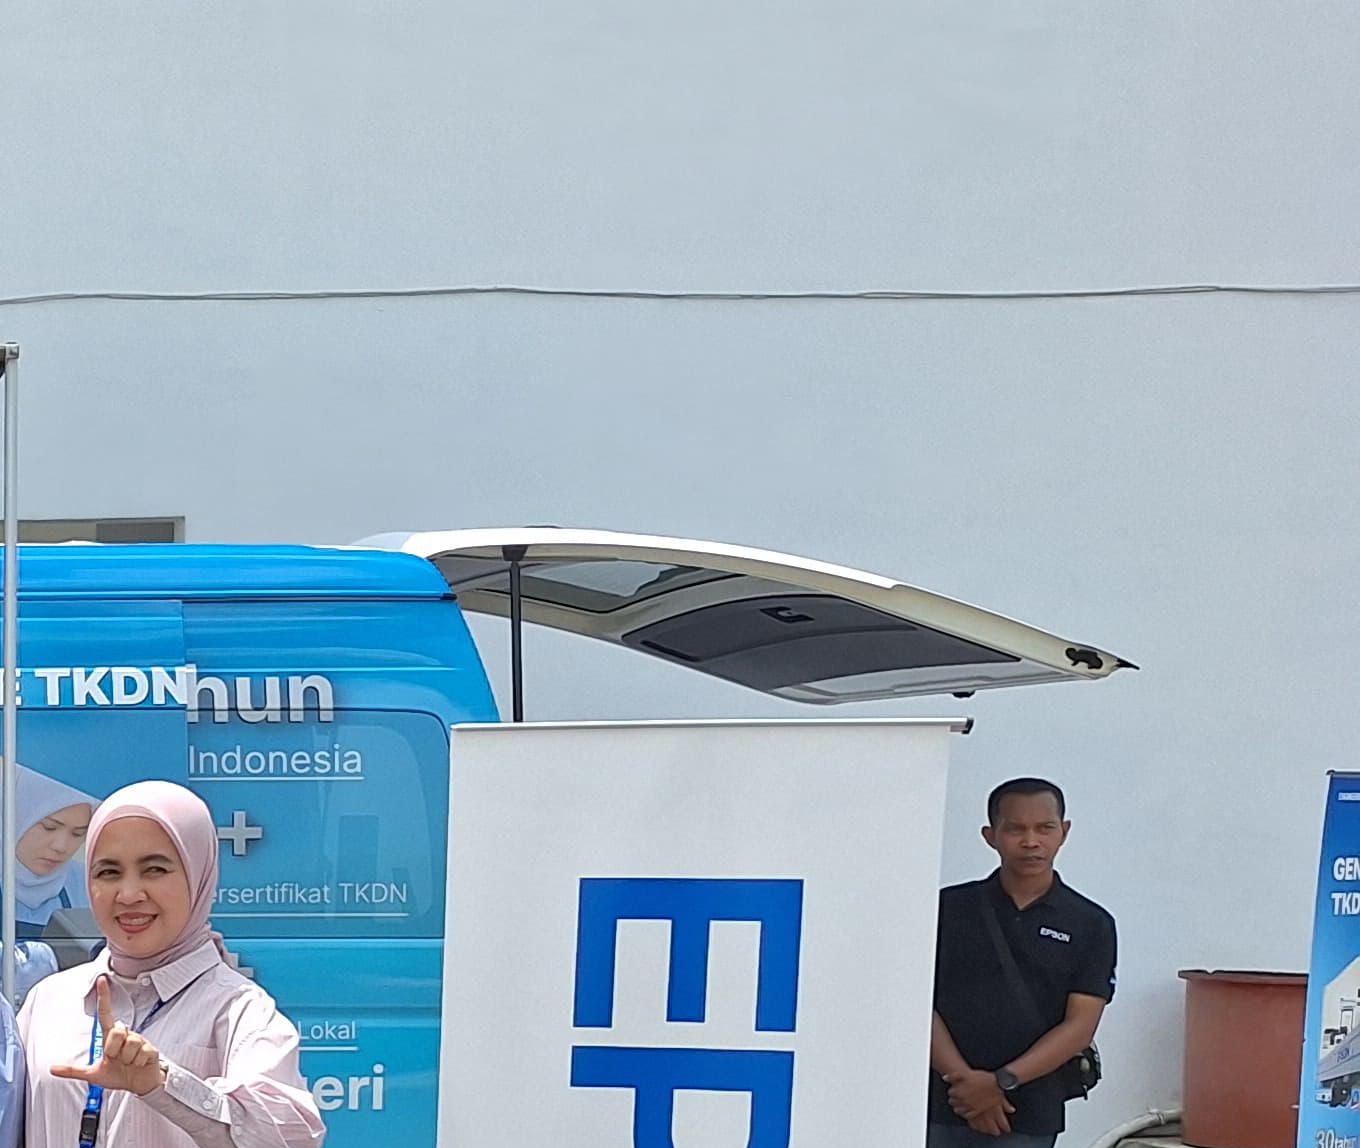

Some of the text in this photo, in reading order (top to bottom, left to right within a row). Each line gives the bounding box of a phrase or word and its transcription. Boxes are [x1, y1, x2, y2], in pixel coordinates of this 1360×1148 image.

[34, 667, 188, 706] TKDN
[189, 743, 363, 775] Indonesia
[339, 883, 407, 903] TKDN
[1040, 927, 1071, 943] EPSON
[298, 1021, 356, 1040] Lokal
[306, 1063, 384, 1111] eri
